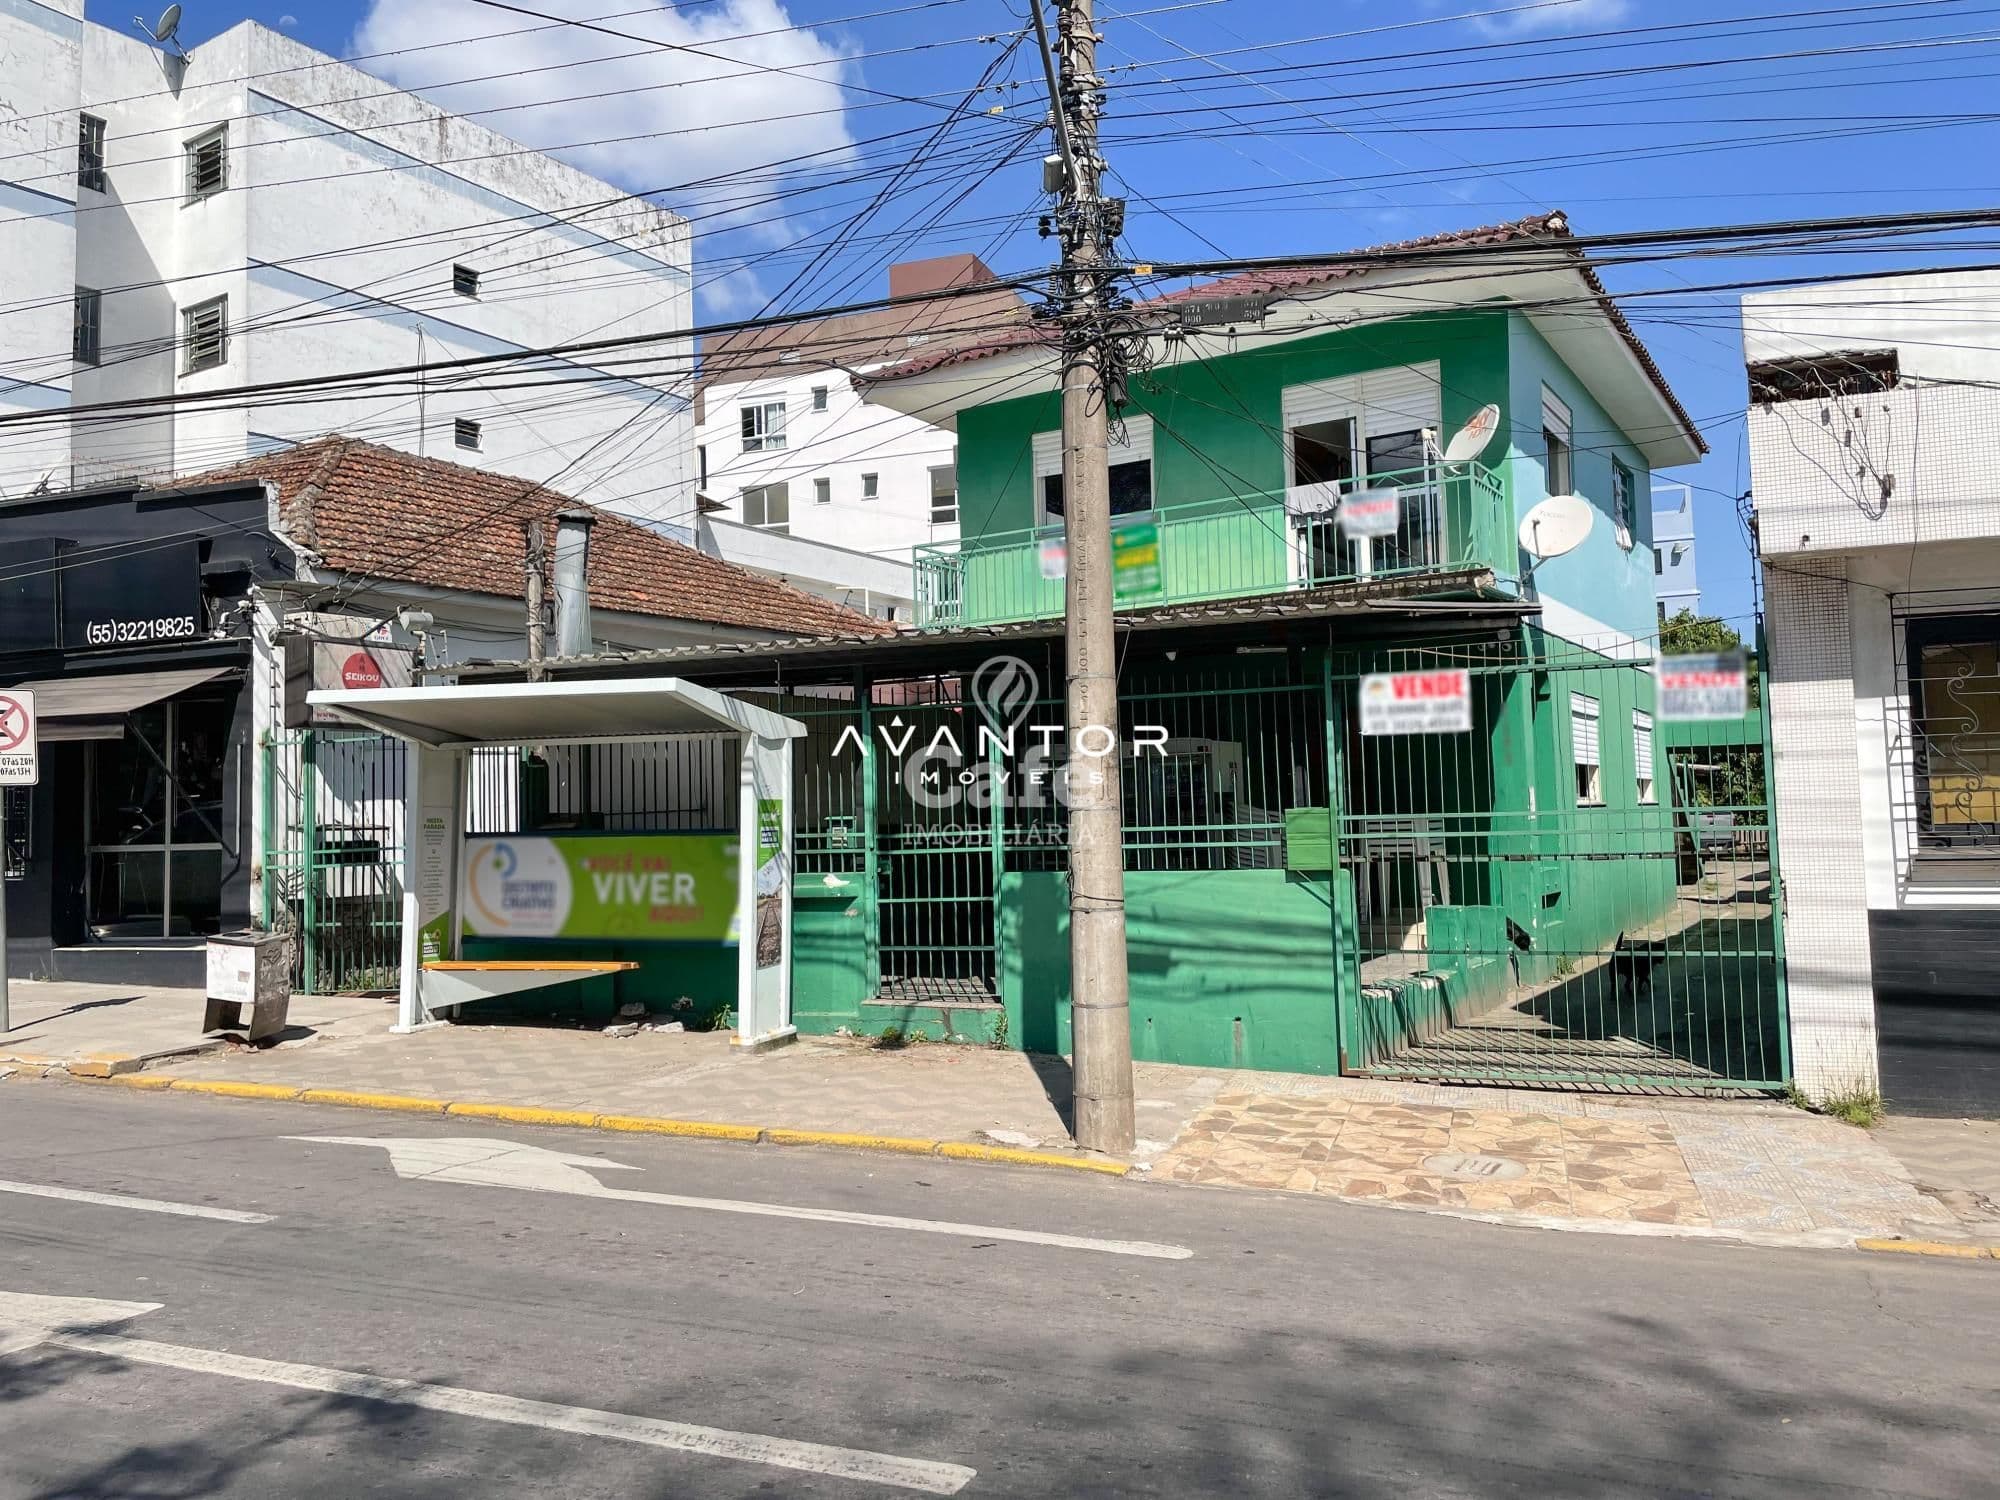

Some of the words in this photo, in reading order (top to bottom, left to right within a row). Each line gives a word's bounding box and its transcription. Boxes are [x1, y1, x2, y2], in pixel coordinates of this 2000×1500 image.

[86, 616, 196, 645] (55)32219825
[344, 671, 380, 682] SEIKOU
[592, 872, 697, 904] VIVER
